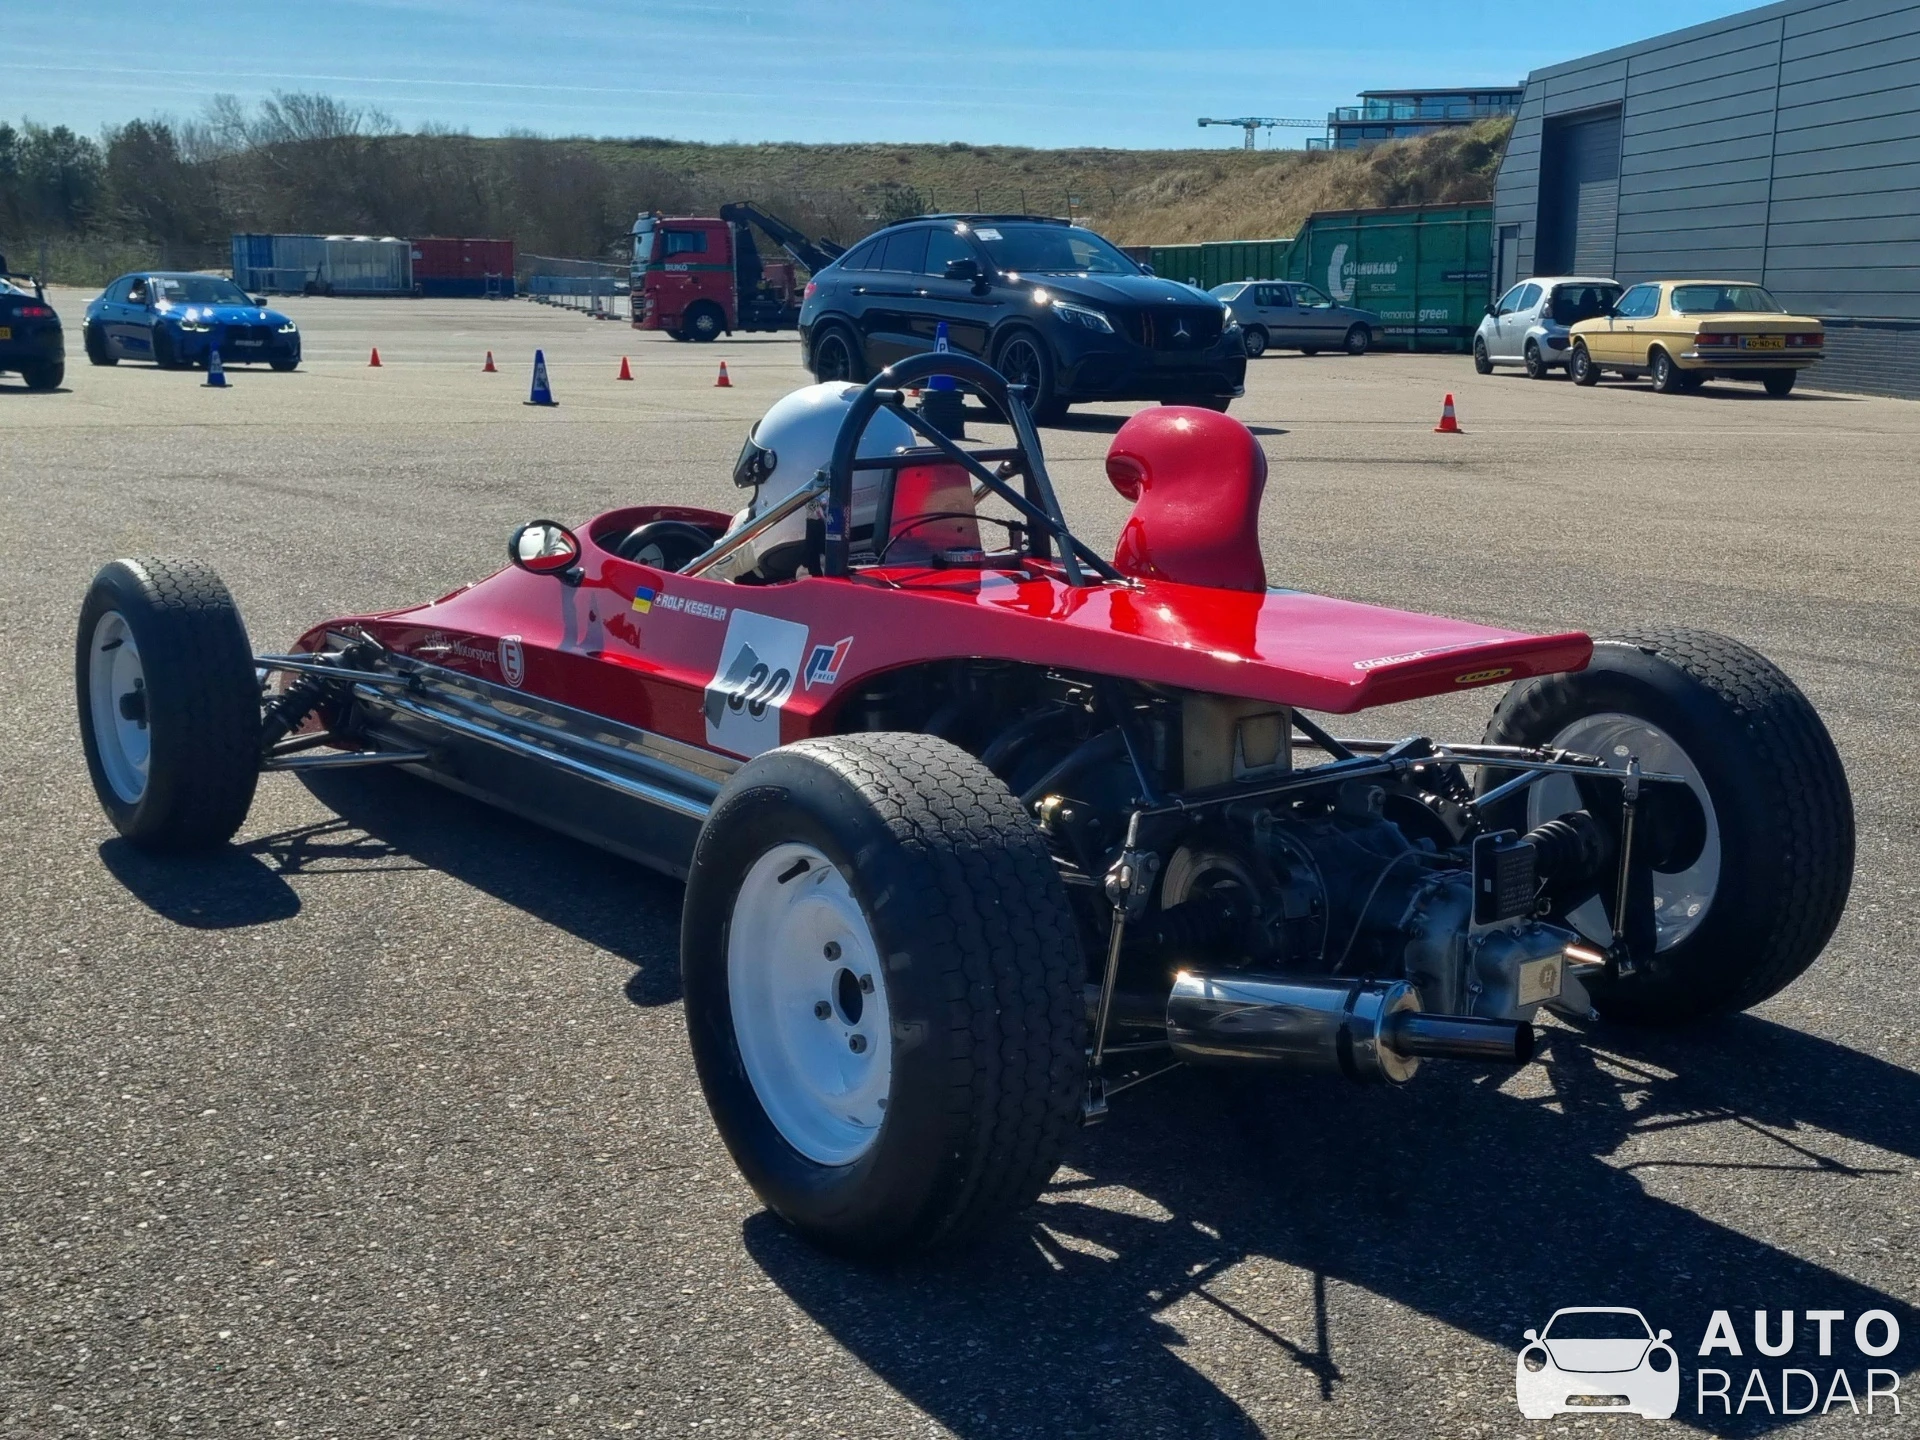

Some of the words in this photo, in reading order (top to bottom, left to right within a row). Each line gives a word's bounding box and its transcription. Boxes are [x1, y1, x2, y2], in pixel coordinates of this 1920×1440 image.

[1419, 309, 1448, 322] green
[661, 594, 685, 612] ROLF
[684, 599, 728, 621] KESSLER
[1460, 669, 1506, 682] LOLA
[727, 662, 792, 722] 30
